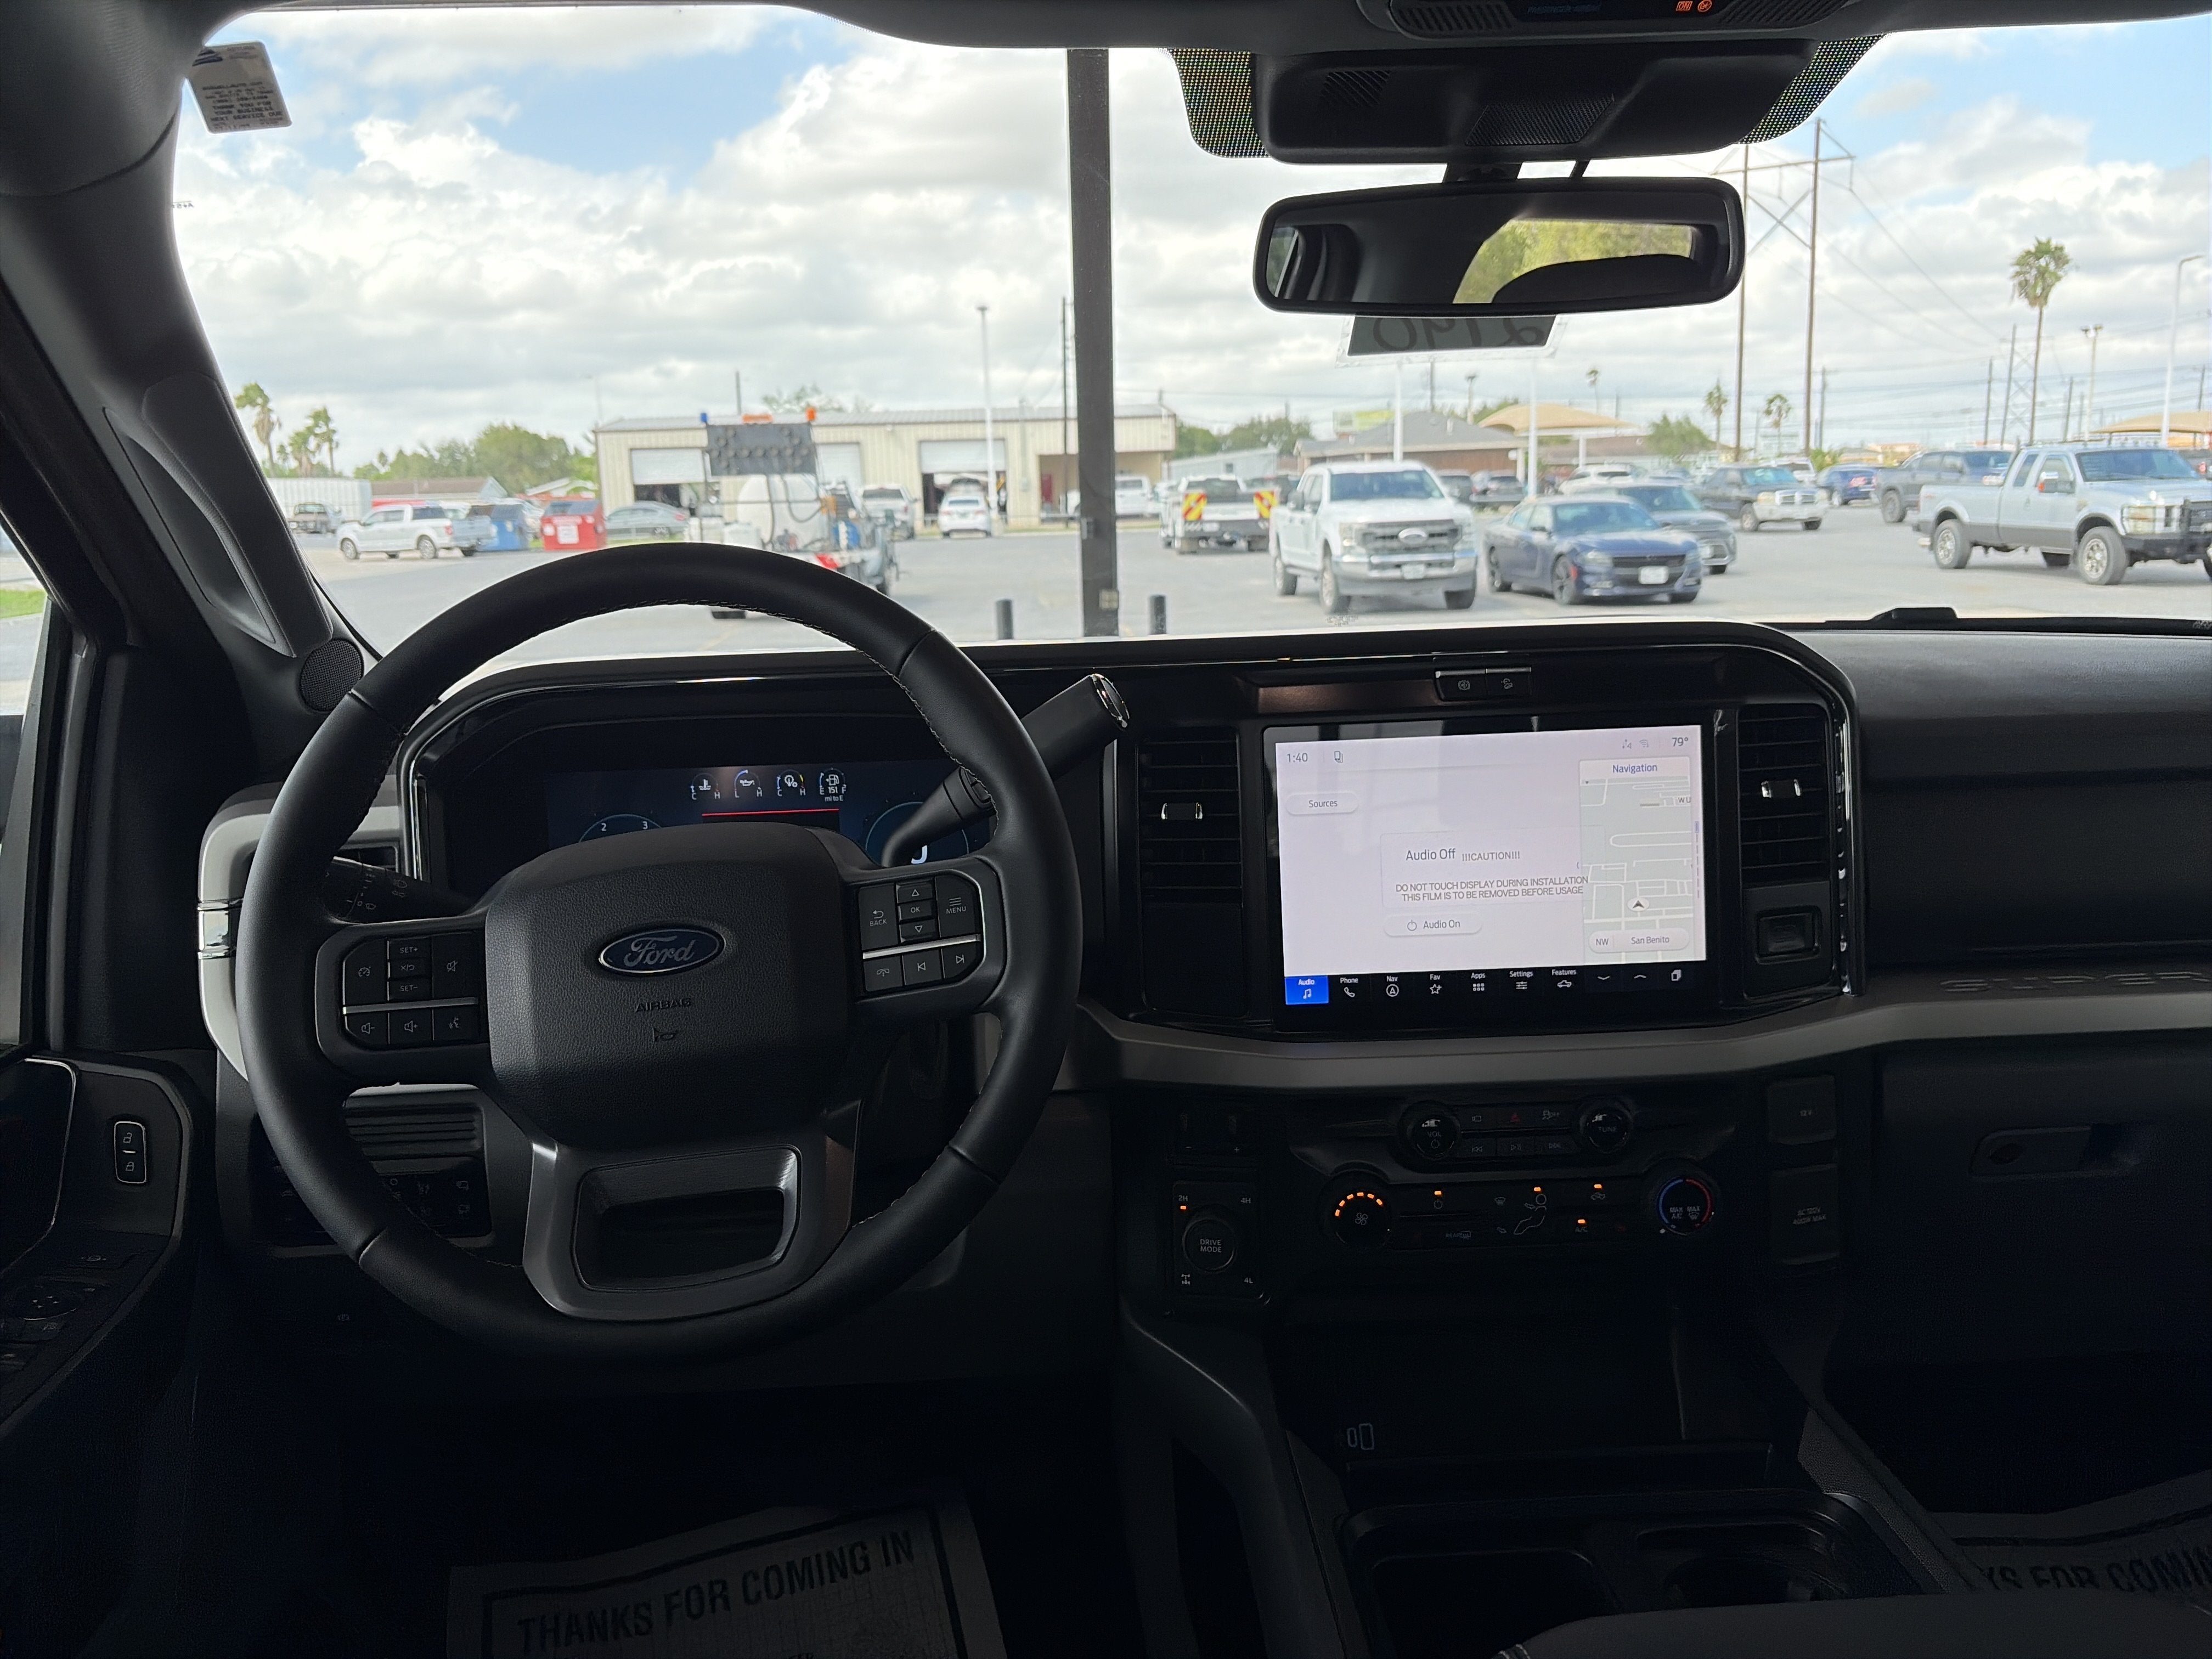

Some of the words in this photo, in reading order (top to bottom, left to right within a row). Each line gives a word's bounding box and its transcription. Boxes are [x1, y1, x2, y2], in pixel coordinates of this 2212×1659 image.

[1672, 737, 1689, 747] 79°
[1286, 752, 1308, 763] 1:40
[1612, 764, 1657, 774] Navigation
[601, 822, 607, 832] 2
[641, 821, 648, 830] 3
[1406, 850, 1437, 861] Audio
[1439, 848, 1456, 860] Off
[1396, 884, 1408, 892] DO
[1409, 883, 1427, 891] NOT
[1429, 882, 1459, 890] TOUCH
[1460, 880, 1494, 889] DISPLAY
[1496, 878, 1529, 888] DURING
[1530, 876, 1589, 886] INSTALLATION
[1401, 893, 1421, 901] THIS
[1422, 892, 1442, 901] FILM
[1443, 891, 1452, 900] IS
[1453, 891, 1465, 900] TO
[1465, 890, 1478, 899] BE
[1478, 888, 1520, 899] REMOVED
[1521, 887, 1554, 896] BEFORE
[1555, 885, 1584, 895] USAGE
[946, 906, 967, 914] MENU
[1423, 920, 1447, 929] Audio
[1448, 919, 1461, 928] On
[1630, 936, 1645, 945] San
[1646, 935, 1670, 944] Benito
[623, 935, 697, 967] Ford
[1470, 972, 1486, 980] Apps
[1509, 970, 1534, 979] Settings
[1551, 968, 1577, 977] Features
[635, 998, 692, 1013] AIRBAG
[517, 1601, 653, 1656] THANKS
[664, 1579, 731, 1626] FOR
[741, 1539, 872, 1606] COMING
[877, 1528, 915, 1567] IN
